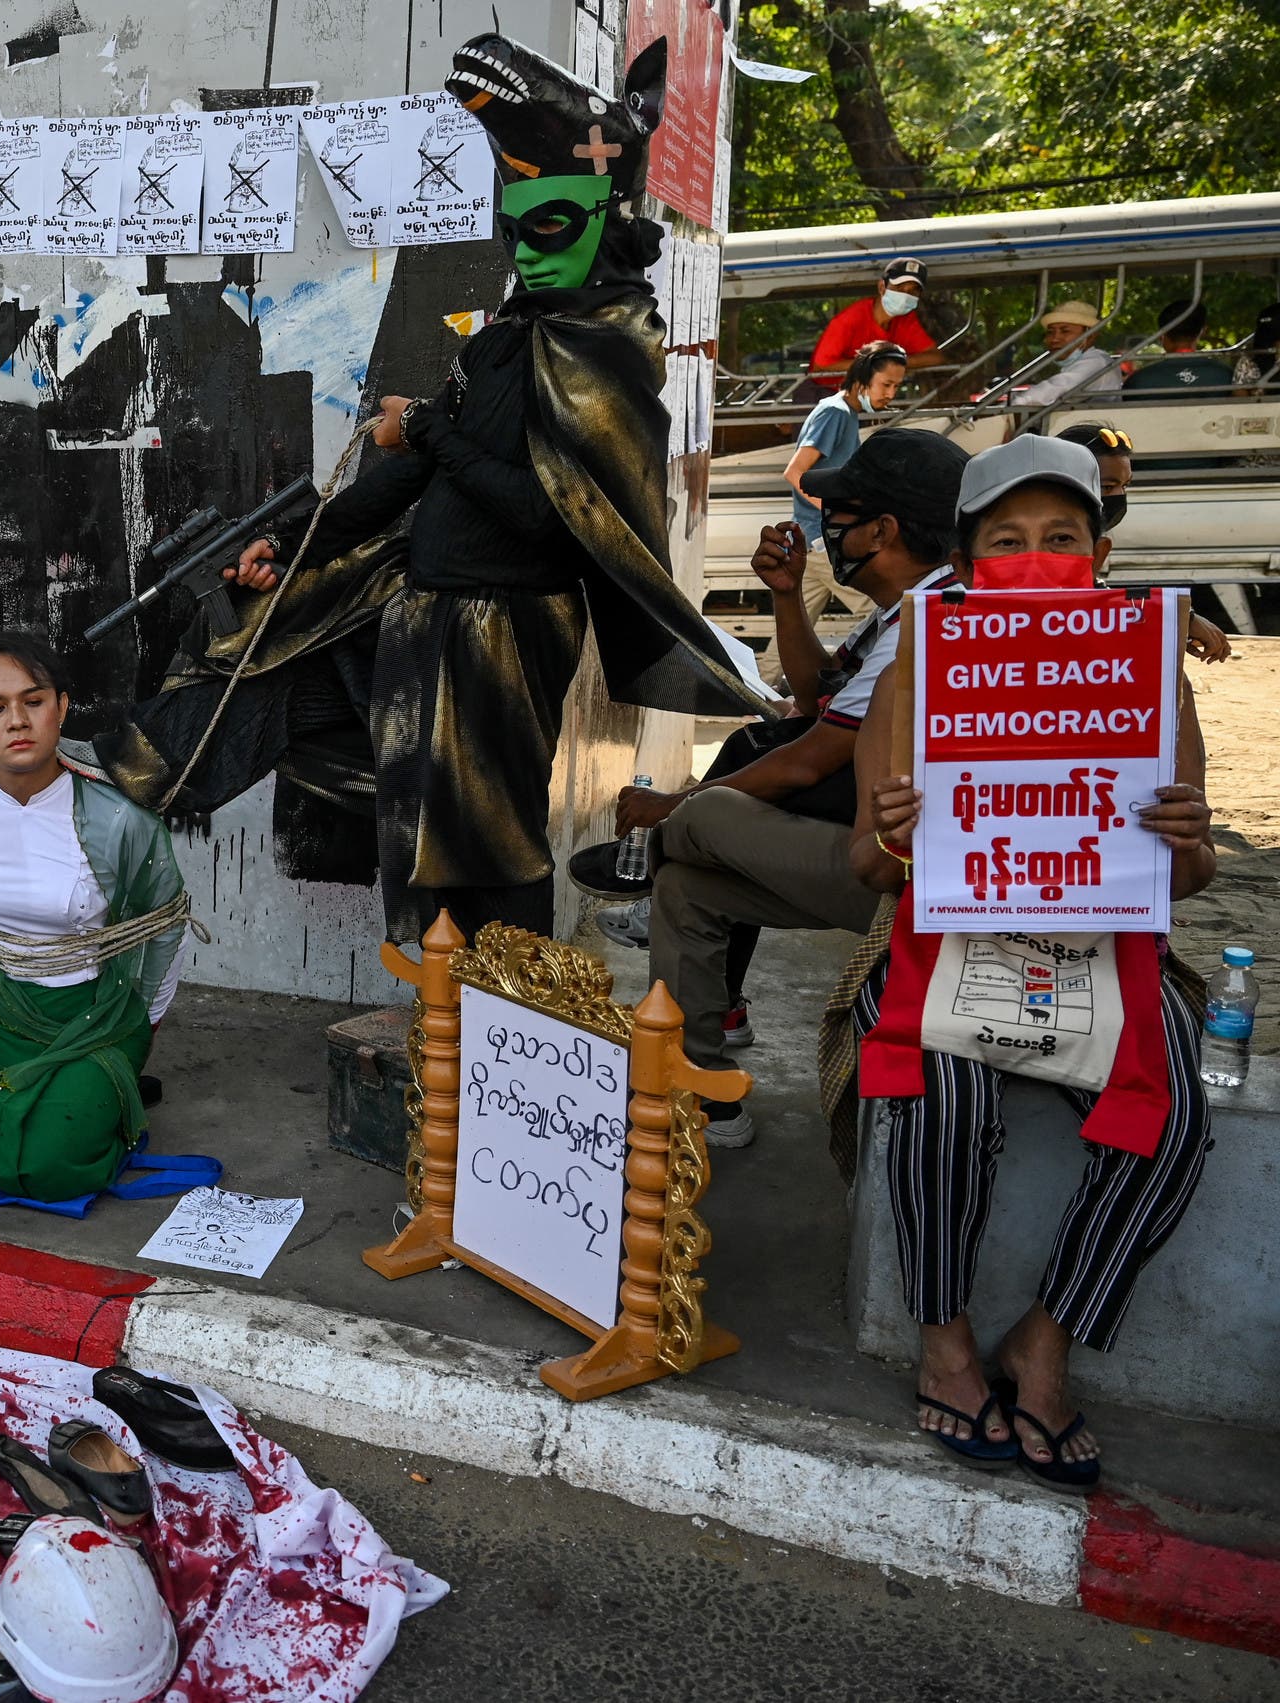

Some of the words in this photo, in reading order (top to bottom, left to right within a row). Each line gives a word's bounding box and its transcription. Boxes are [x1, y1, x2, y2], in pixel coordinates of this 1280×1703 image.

[940, 612, 1031, 641] STOP
[1042, 607, 1142, 636] COUP
[946, 662, 1024, 689] GIVE
[1037, 658, 1134, 686] BACK
[930, 708, 1154, 738] DEMOCRACY
[937, 906, 987, 914] MYANMAR
[990, 906, 1014, 914] CIVIL
[1016, 906, 1090, 914] DISOBEDIENCE
[1092, 906, 1150, 915] MOVEMENT
